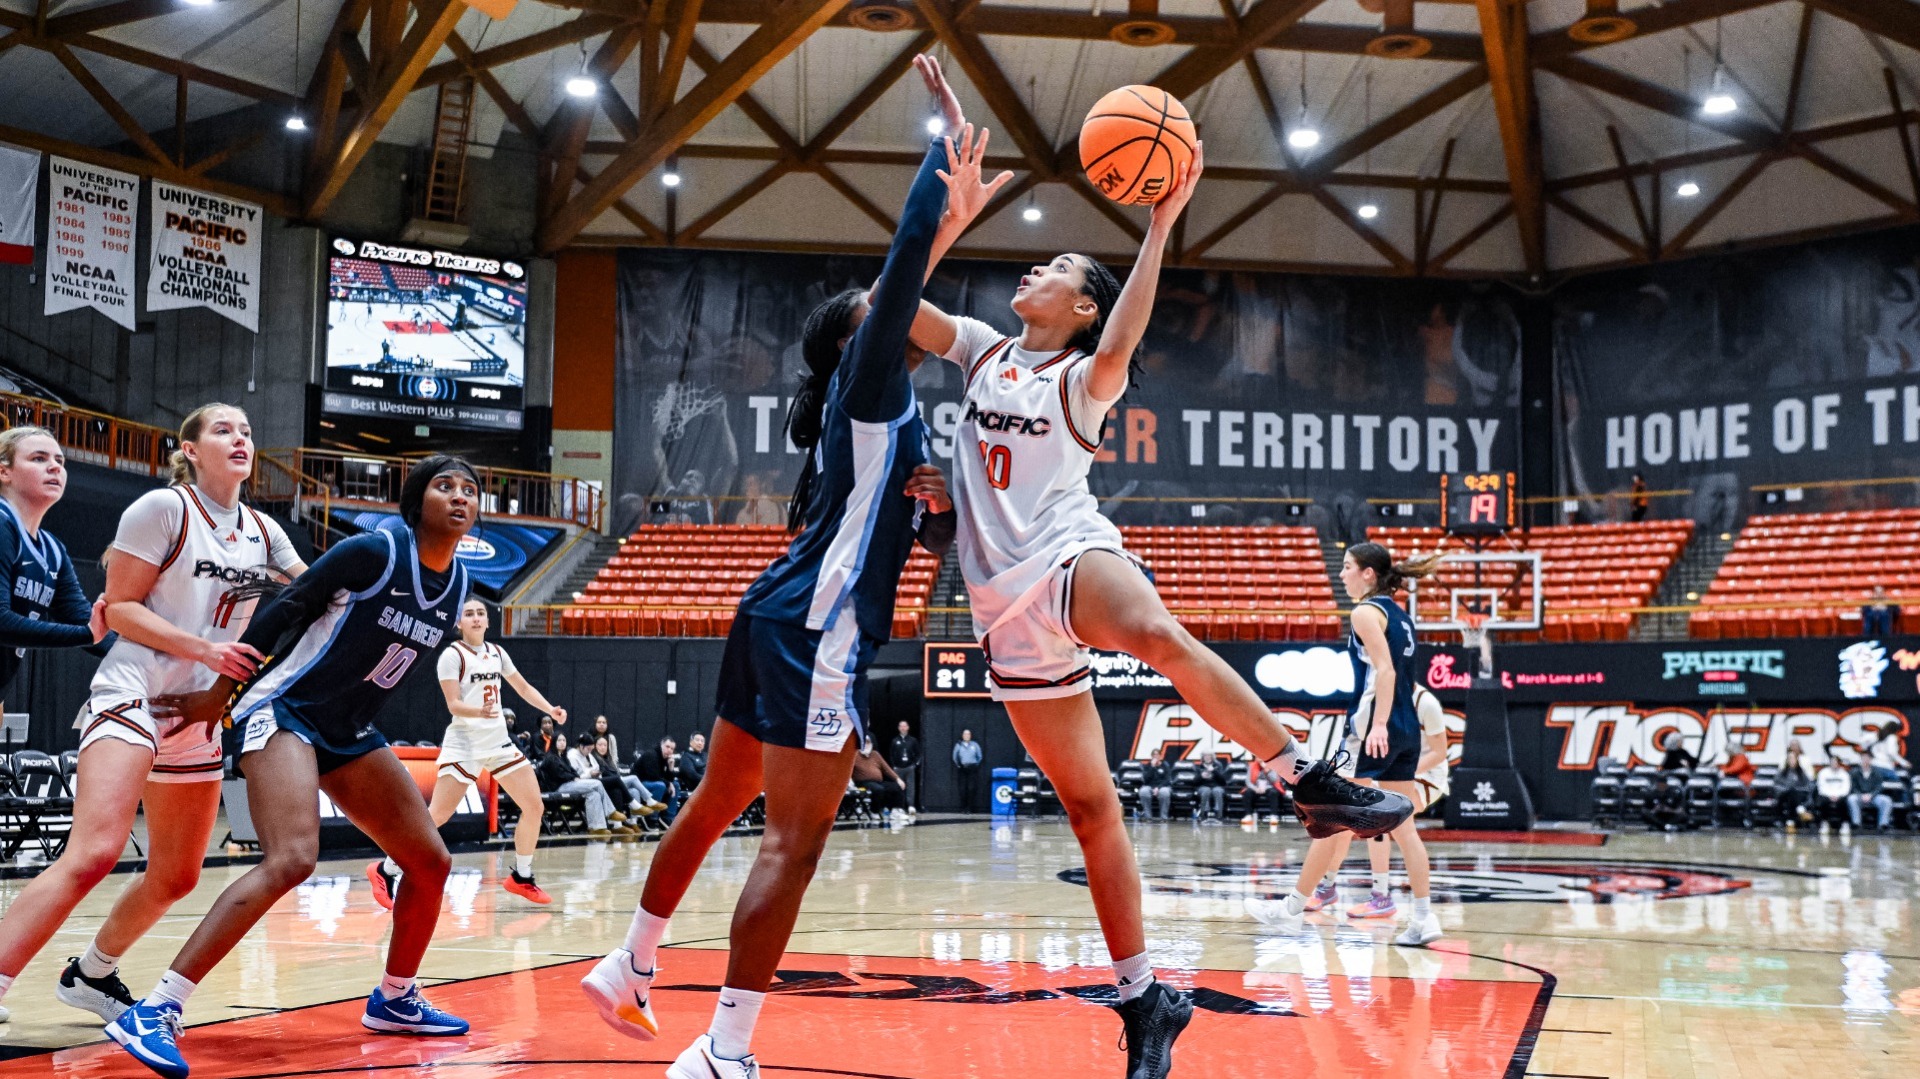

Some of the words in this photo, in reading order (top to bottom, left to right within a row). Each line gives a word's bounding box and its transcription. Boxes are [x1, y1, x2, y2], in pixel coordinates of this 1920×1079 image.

[53, 164, 135, 191] UNIVERSITY
[93, 184, 109, 193] THE
[63, 186, 128, 211] PACIFIC
[159, 187, 256, 221] UNIVERSITY
[57, 200, 85, 215] 1981
[103, 211, 131, 225] 1983
[188, 208, 201, 217] OF
[207, 212, 226, 223] THE
[56, 216, 85, 229] 1984
[103, 225, 130, 239] 1985
[165, 211, 247, 245] PACIFIC
[56, 230, 84, 244] 1986
[102, 240, 129, 254] 1990
[56, 245, 84, 258] 1999
[191, 237, 221, 252] 1986
[183, 246, 227, 267] NCAA
[360, 242, 433, 265] PACIFIC
[433, 251, 501, 274] TIGERS
[66, 261, 116, 282] NCAA
[159, 253, 250, 286] VOLLEYBALL
[52, 273, 129, 296] VOLLEYBALL
[167, 269, 241, 296] NATIONAL
[54, 286, 89, 300] FINAL
[94, 293, 125, 307] FOUR
[160, 281, 247, 310] CHAMPIONS
[351, 398, 376, 411] Best
[379, 401, 424, 416] Western
[428, 406, 454, 418] PLUS
[1183, 409, 1499, 473] TERRITORY
[1606, 402, 1750, 469] HOME
[1772, 394, 1841, 454] OF
[1469, 493, 1498, 524] 19
[14, 576, 43, 602] SAN
[213, 591, 239, 629] 11
[378, 605, 414, 637] SAN
[410, 619, 444, 648] DIEGO
[1401, 620, 1415, 657] 3
[363, 642, 418, 689] 10
[938, 652, 966, 665] PAC
[1661, 649, 1785, 680] PACIFIC
[936, 668, 966, 688] 21
[1516, 673, 1547, 685] March
[1548, 674, 1573, 685] Lane
[483, 684, 499, 705] 21
[1545, 701, 1910, 771] TIGERS
[20, 758, 53, 767] PACIFIC
